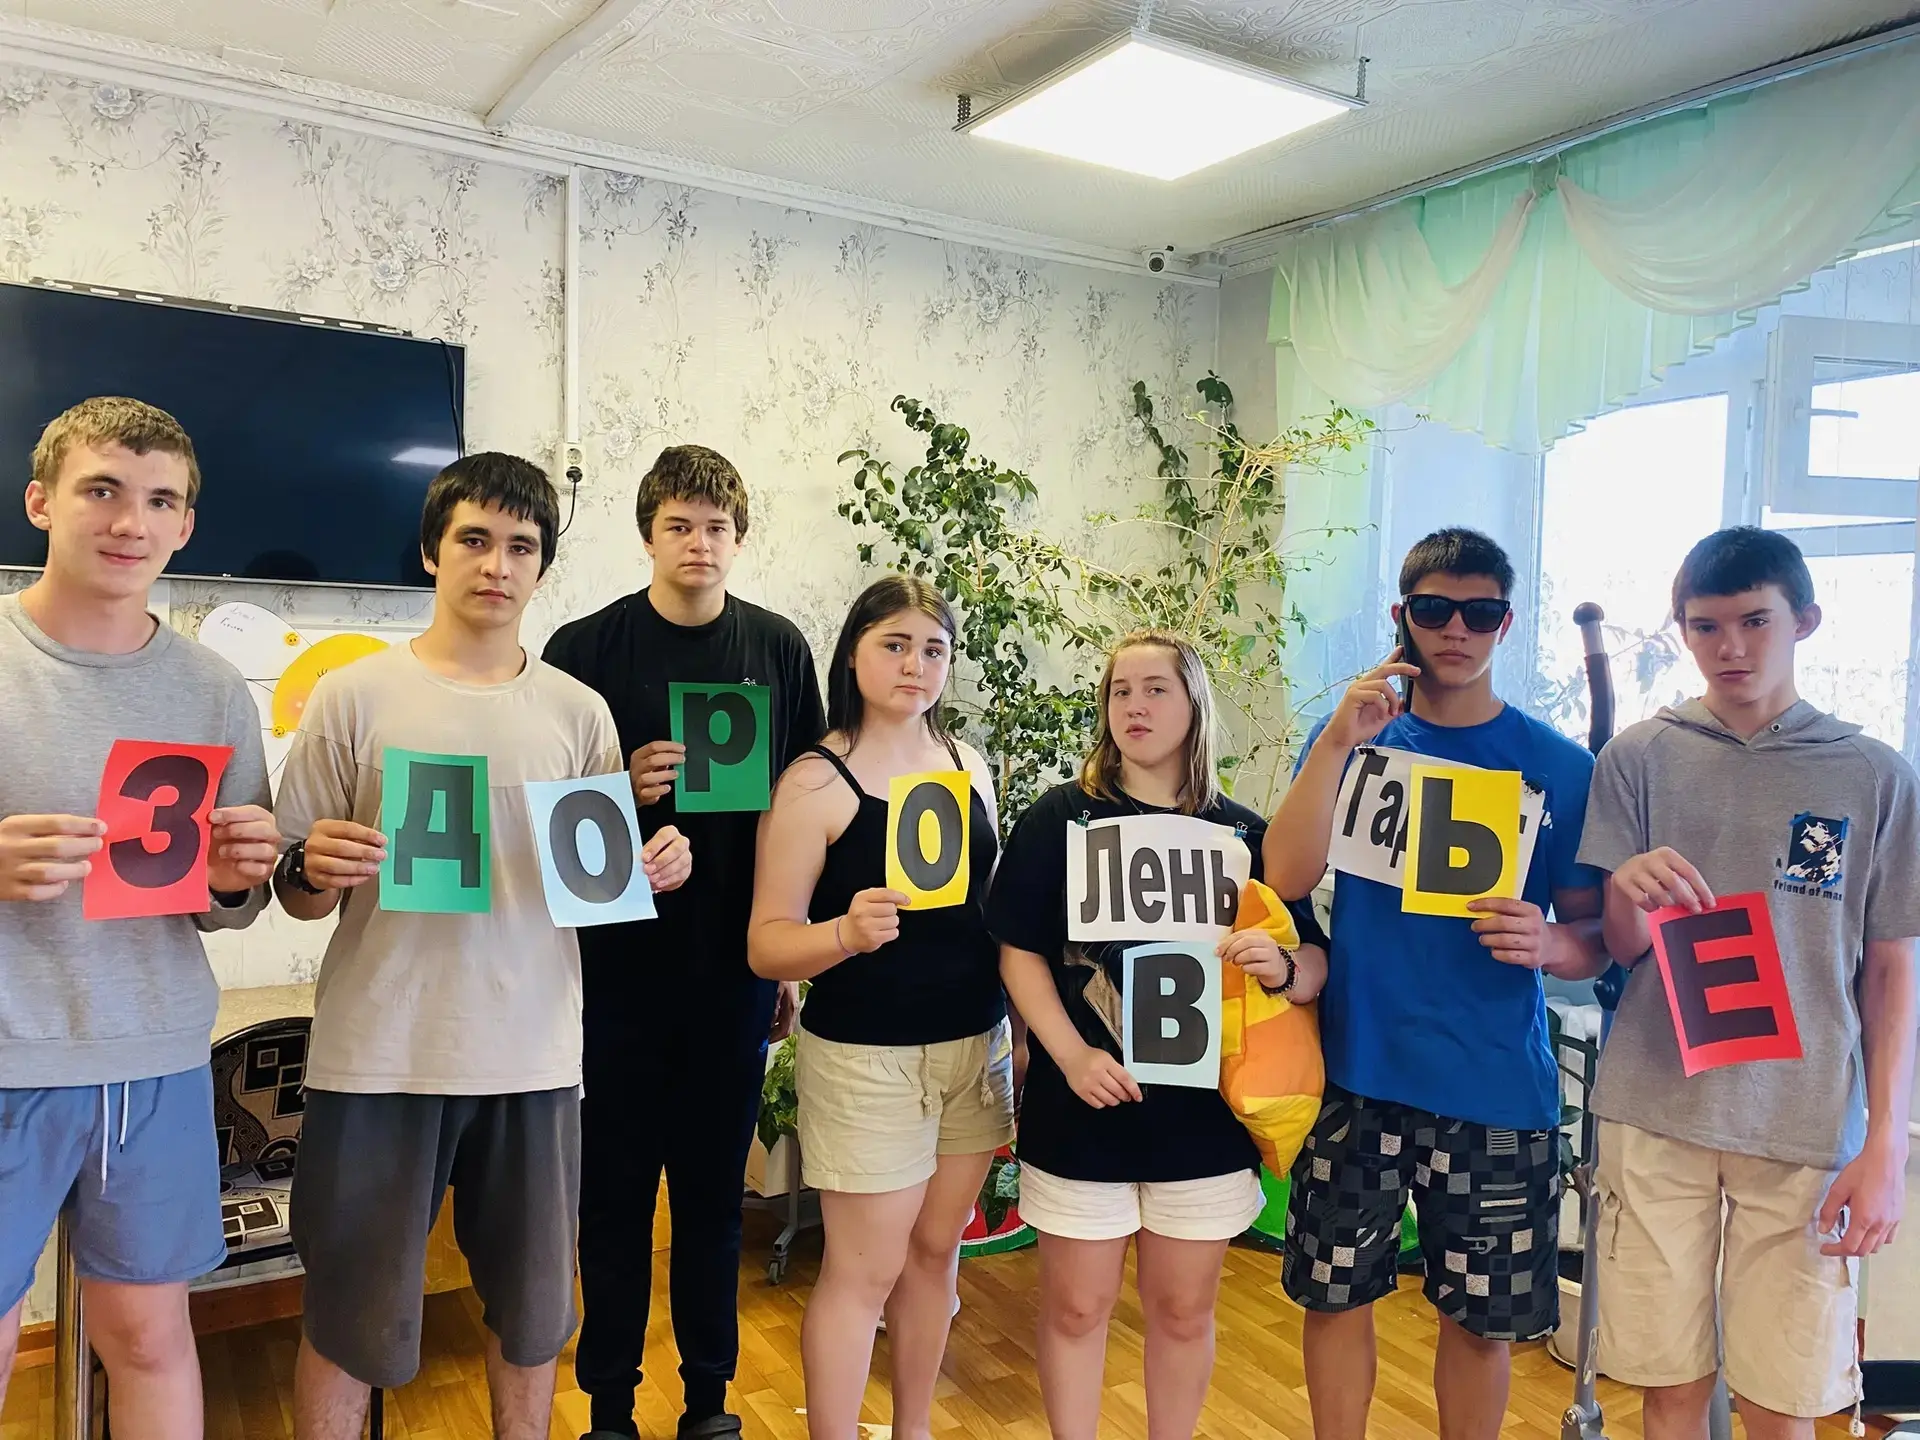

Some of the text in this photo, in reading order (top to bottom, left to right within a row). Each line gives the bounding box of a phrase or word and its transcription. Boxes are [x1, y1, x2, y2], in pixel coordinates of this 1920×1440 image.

[109, 754, 209, 888] З
[393, 760, 481, 888] Д
[1080, 824, 1239, 927] Лень
[1773, 879, 1806, 895] friend
[1808, 886, 1821, 897] of
[1659, 907, 1779, 1049] Е
